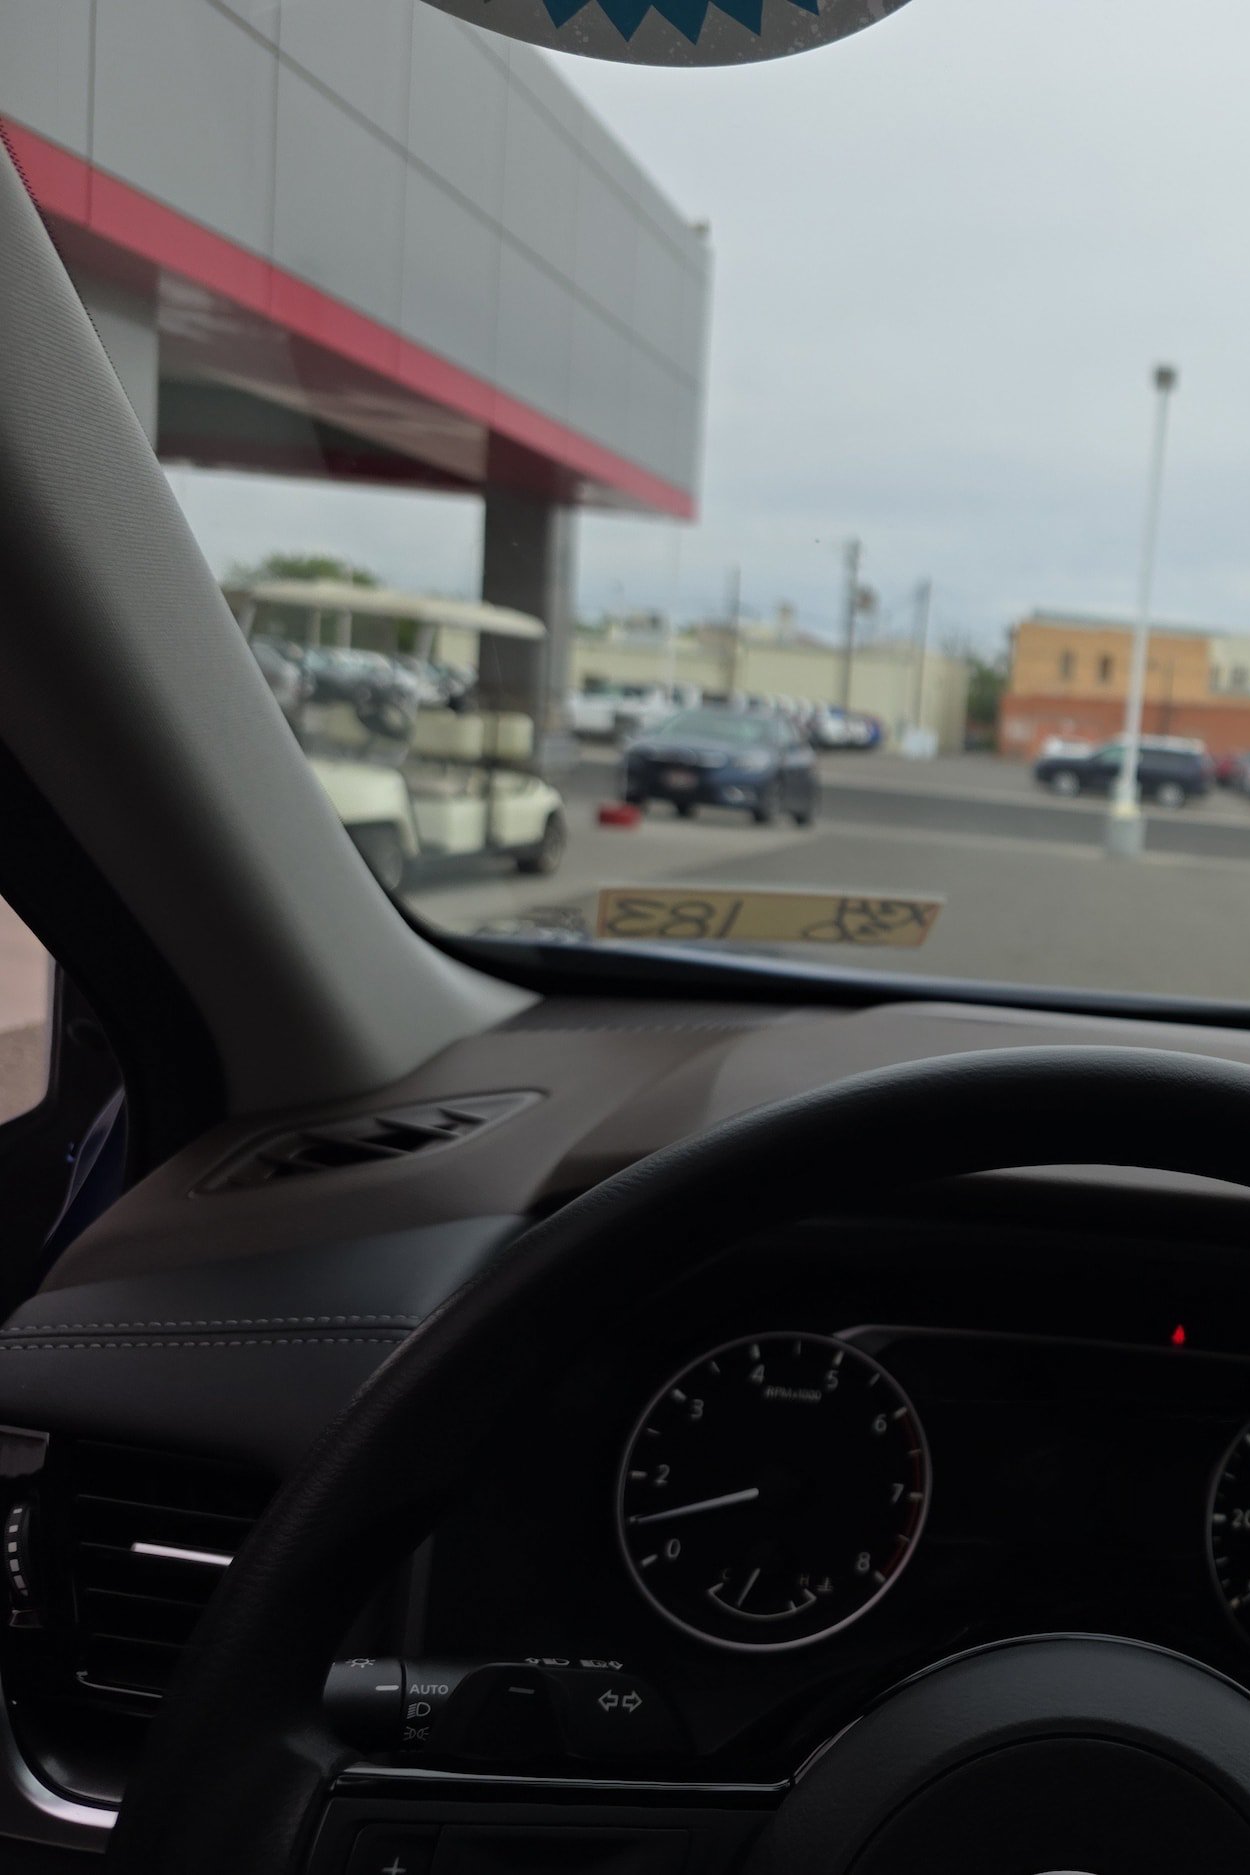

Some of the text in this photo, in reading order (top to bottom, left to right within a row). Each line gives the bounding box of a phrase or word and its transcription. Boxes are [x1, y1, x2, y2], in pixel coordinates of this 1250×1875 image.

[749, 1363, 766, 1384] 4
[825, 1370, 840, 1391] 5
[689, 1399, 705, 1421] 3
[873, 1413, 889, 1435] 6
[653, 1464, 672, 1487] 2
[890, 1481, 905, 1505] 7
[664, 1538, 683, 1560] 0
[856, 1552, 871, 1575] 8
[409, 1683, 449, 1695] AUTO
